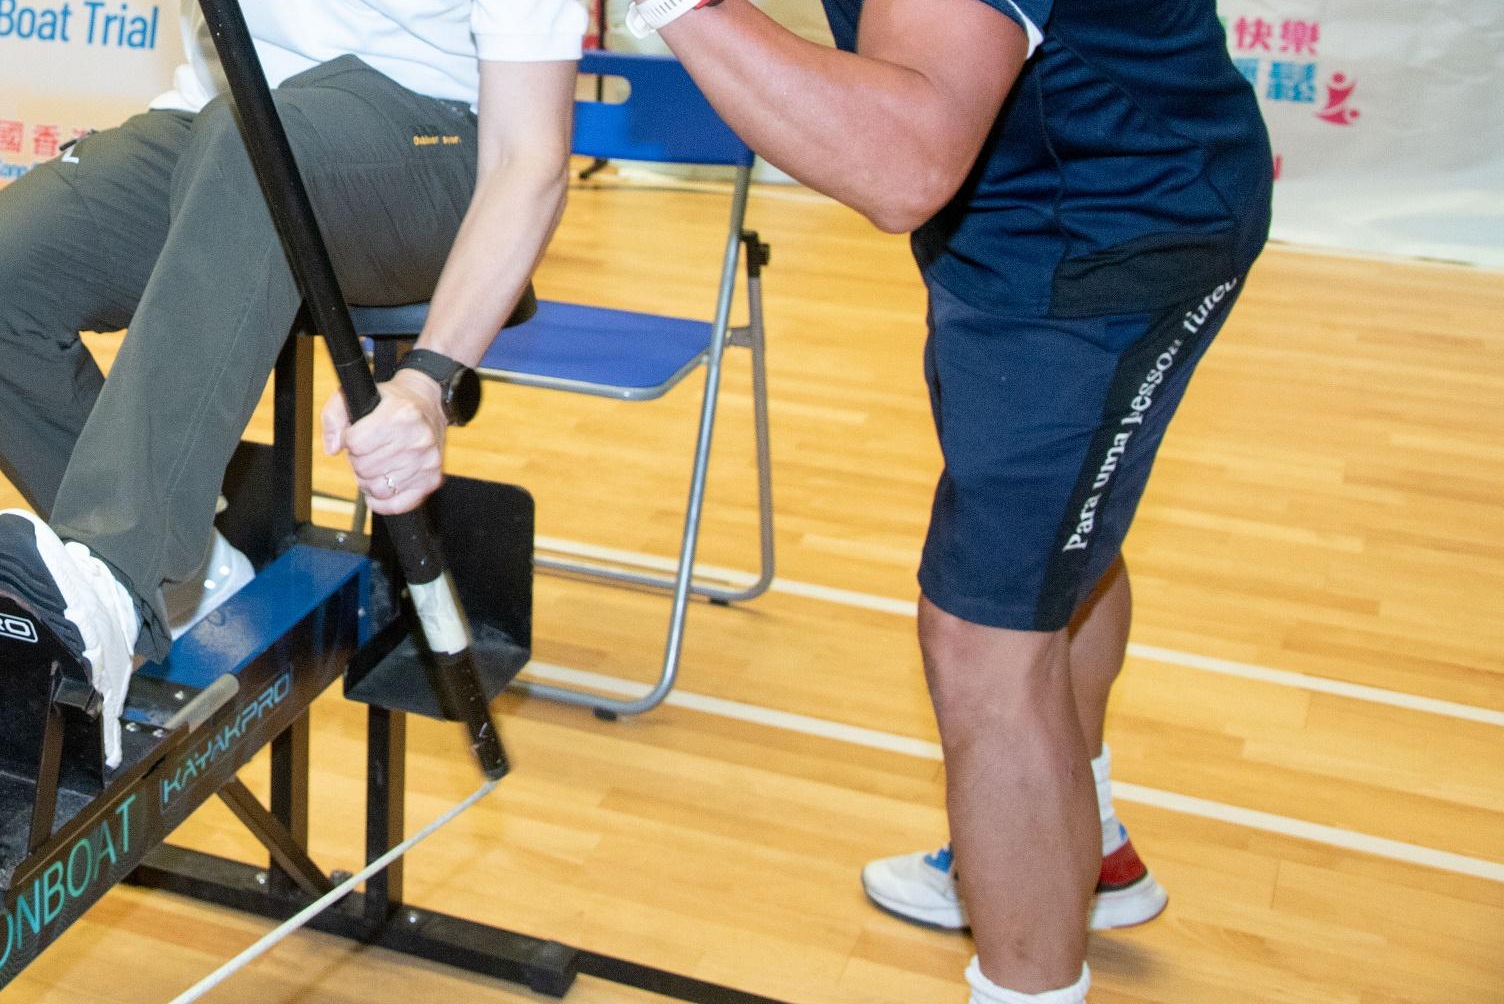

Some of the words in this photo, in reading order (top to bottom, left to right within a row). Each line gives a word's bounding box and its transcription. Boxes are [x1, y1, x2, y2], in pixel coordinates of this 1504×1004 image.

[84, 0, 160, 49] Trial
[1233, 16, 1320, 57] 快樂
[1061, 493, 1101, 553] Para
[163, 673, 290, 805] KAYAKPRO
